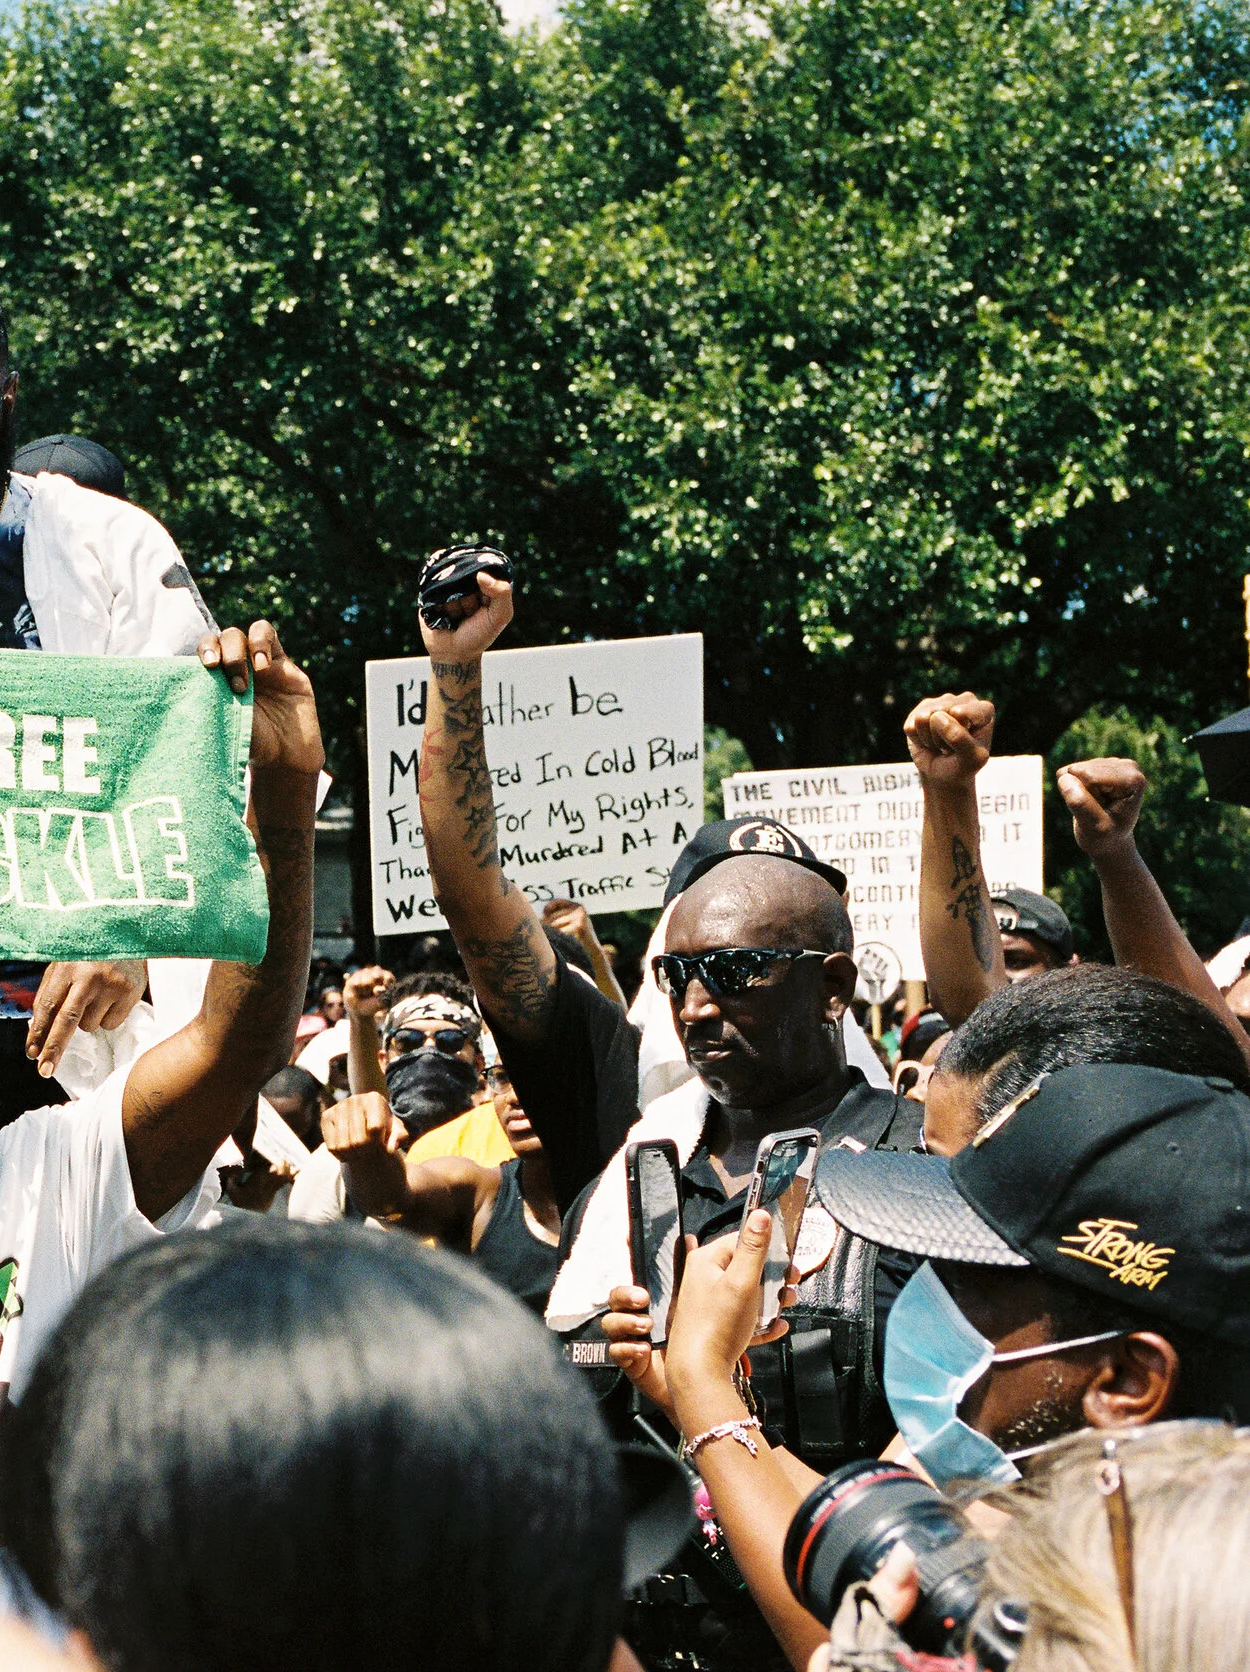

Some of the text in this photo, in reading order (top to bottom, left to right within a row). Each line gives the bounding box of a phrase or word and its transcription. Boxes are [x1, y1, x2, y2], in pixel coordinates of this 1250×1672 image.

[396, 675, 623, 728] I'd ather be
[536, 752, 573, 786] In
[585, 748, 636, 776] Cold
[649, 737, 699, 767] Blood
[730, 782, 773, 802] THE
[788, 777, 847, 798] CIVIL
[980, 792, 1030, 815] EGIN
[548, 800, 585, 834] My
[596, 787, 695, 823] Rights,
[1003, 823, 1022, 843] IT
[379, 857, 430, 885] Tha
[621, 829, 658, 854] At
[673, 822, 688, 844] A
[559, 875, 636, 900] Traffic
[1062, 1217, 1176, 1270] STRONG
[572, 1342, 607, 1364] BROWN
